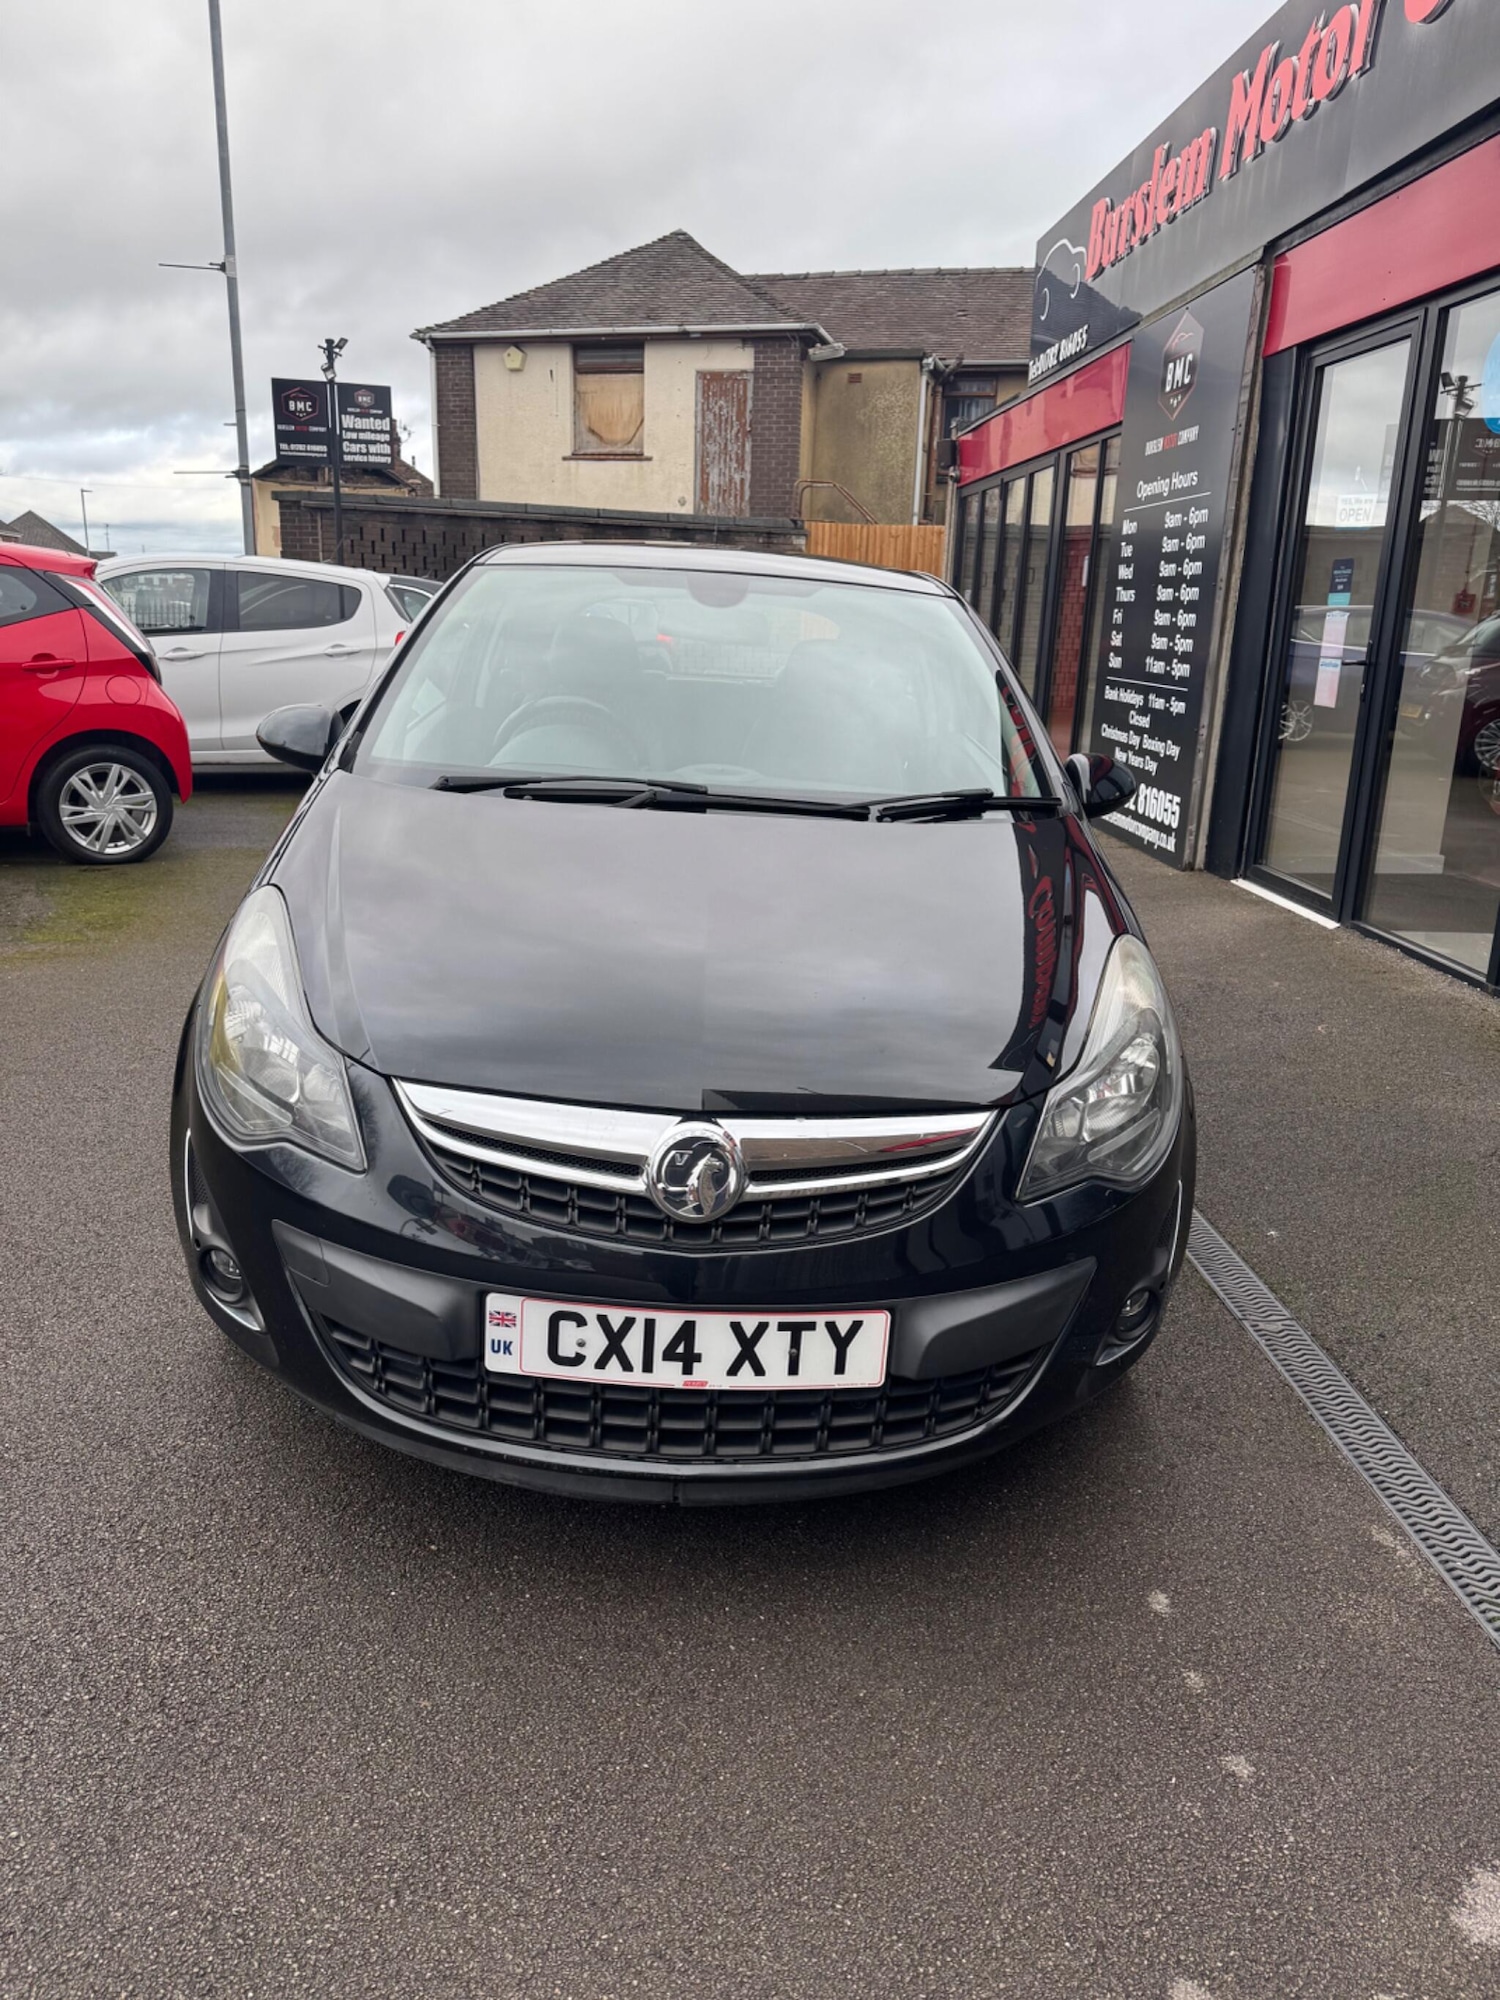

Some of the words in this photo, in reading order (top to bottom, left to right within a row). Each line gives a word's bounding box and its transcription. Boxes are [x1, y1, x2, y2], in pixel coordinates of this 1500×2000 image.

[1085, 127, 1216, 281] Burslem
[1165, 353, 1193, 392] BMC
[288, 400, 313, 412] BMC
[341, 414, 390, 431] Wanted
[342, 430, 358, 440] Low
[358, 431, 390, 442] mileage
[343, 441, 367, 453] Cars
[368, 442, 391, 454] with
[343, 454, 367, 462] service
[368, 454, 391, 464] history
[1137, 474, 1170, 501] Opening
[1171, 468, 1198, 491] Hours
[1122, 519, 1137, 535] Mon
[1165, 511, 1182, 528] 9am
[1189, 507, 1208, 528] 6pm
[1339, 507, 1372, 522] OPEN
[1121, 542, 1133, 557] Tue
[1162, 536, 1179, 553] 9am
[1186, 532, 1205, 554] 6pm
[1118, 563, 1134, 580] Wed
[1159, 560, 1177, 577] 9am
[1183, 558, 1202, 580] 6pm
[1116, 586, 1136, 602] Thurs
[1157, 584, 1174, 602] 9am
[1180, 583, 1200, 605] 6pm
[1113, 608, 1123, 625] Fri
[1154, 608, 1171, 626] 9am
[1177, 609, 1196, 631] 6pm
[1111, 630, 1122, 647] Sat
[1151, 632, 1168, 650] 9am
[1174, 634, 1193, 656] 5pm
[1108, 651, 1122, 669] Sun
[1145, 656, 1165, 675] 11am
[1171, 658, 1191, 680] 5pm
[1104, 685, 1119, 700] Bank
[1119, 687, 1144, 709] Holidays
[1148, 693, 1165, 710] 11am
[1170, 696, 1186, 716] 5pm
[1129, 709, 1151, 729] Closed
[1101, 723, 1128, 744] Christmas
[1128, 730, 1141, 750] Day
[1142, 733, 1166, 758] Boxing
[1166, 739, 1181, 761] Day
[1114, 746, 1127, 763] New
[1127, 750, 1144, 769] Years
[1144, 755, 1158, 776] Day
[1137, 782, 1181, 829] 816055
[491, 1338, 513, 1356] UK
[547, 1310, 702, 1377] CX14
[726, 1320, 864, 1377] XTY
